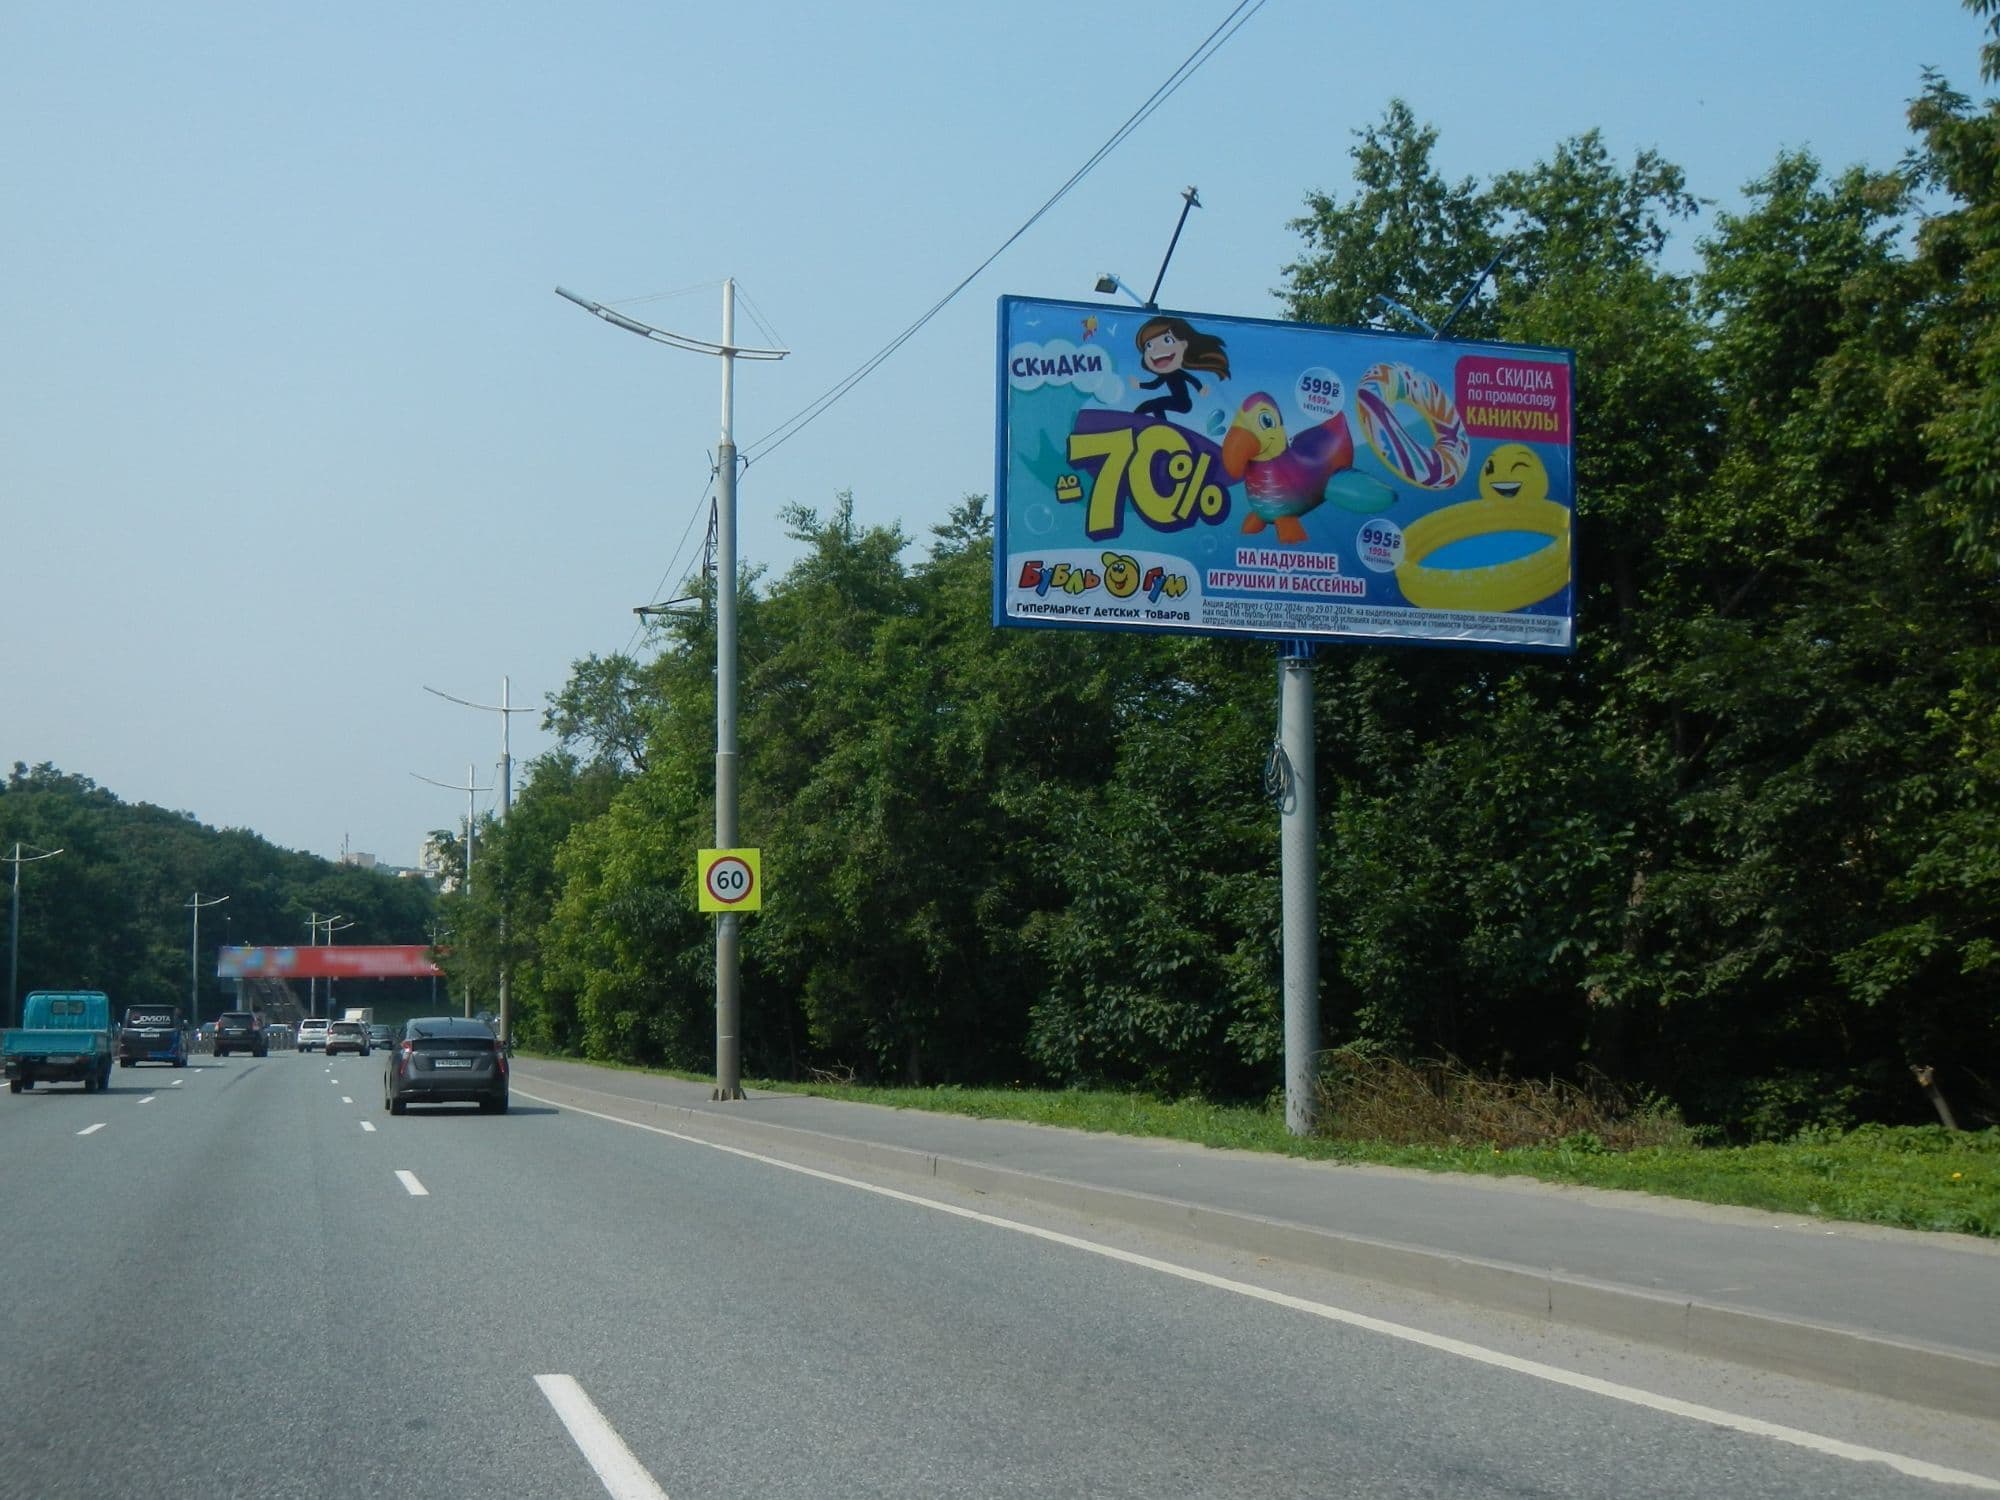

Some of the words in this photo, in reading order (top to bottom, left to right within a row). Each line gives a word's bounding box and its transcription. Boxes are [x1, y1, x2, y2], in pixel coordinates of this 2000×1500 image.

[1466, 371, 1493, 385] доп.
[1496, 367, 1554, 391] СКИДКА
[1468, 389, 1482, 400] по
[1485, 390, 1556, 410] промослову
[1467, 405, 1558, 432] КАНИКУЛЫ
[1239, 551, 1256, 564] НА
[1261, 553, 1335, 569] НАДУВНЫЕ
[1210, 572, 1275, 588] ИГРУШКИ
[1280, 577, 1288, 589] И
[1292, 575, 1363, 594] БАССЕЙНЫ
[717, 870, 743, 889] 60
